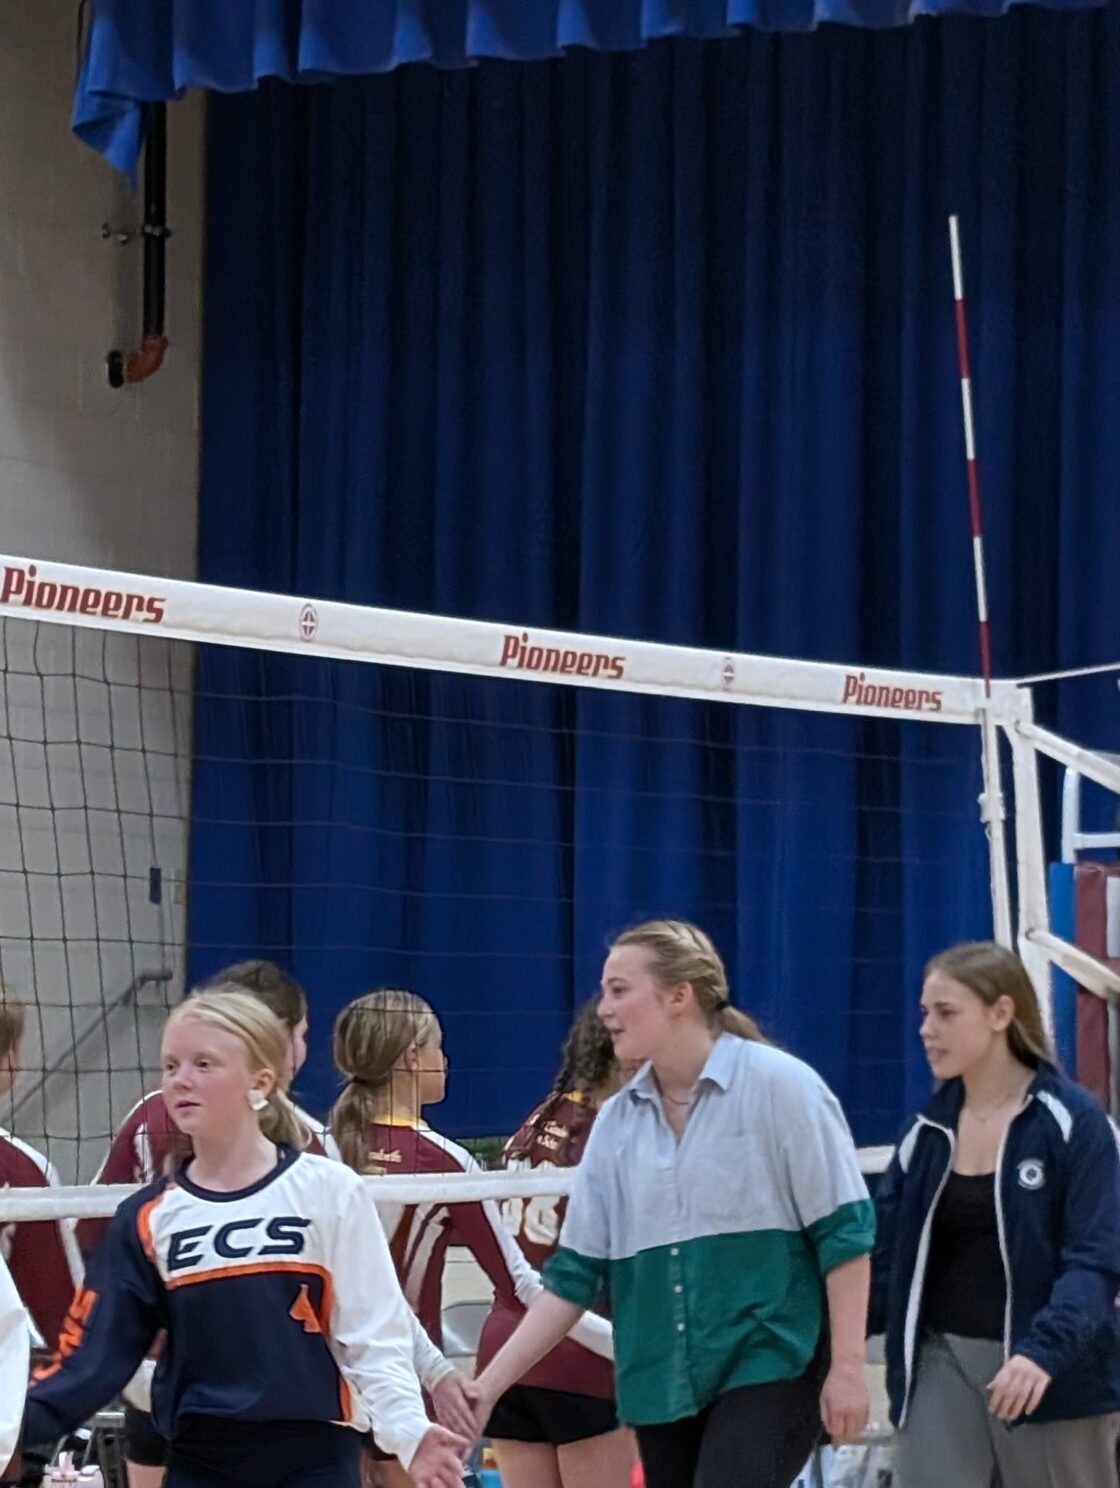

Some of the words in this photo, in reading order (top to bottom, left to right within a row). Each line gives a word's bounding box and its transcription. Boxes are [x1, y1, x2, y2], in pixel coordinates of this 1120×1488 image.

[0, 564, 166, 624] Pioneers
[500, 632, 626, 680] Pioneers
[842, 672, 942, 712] Pioneers
[167, 1216, 311, 1271] ECS
